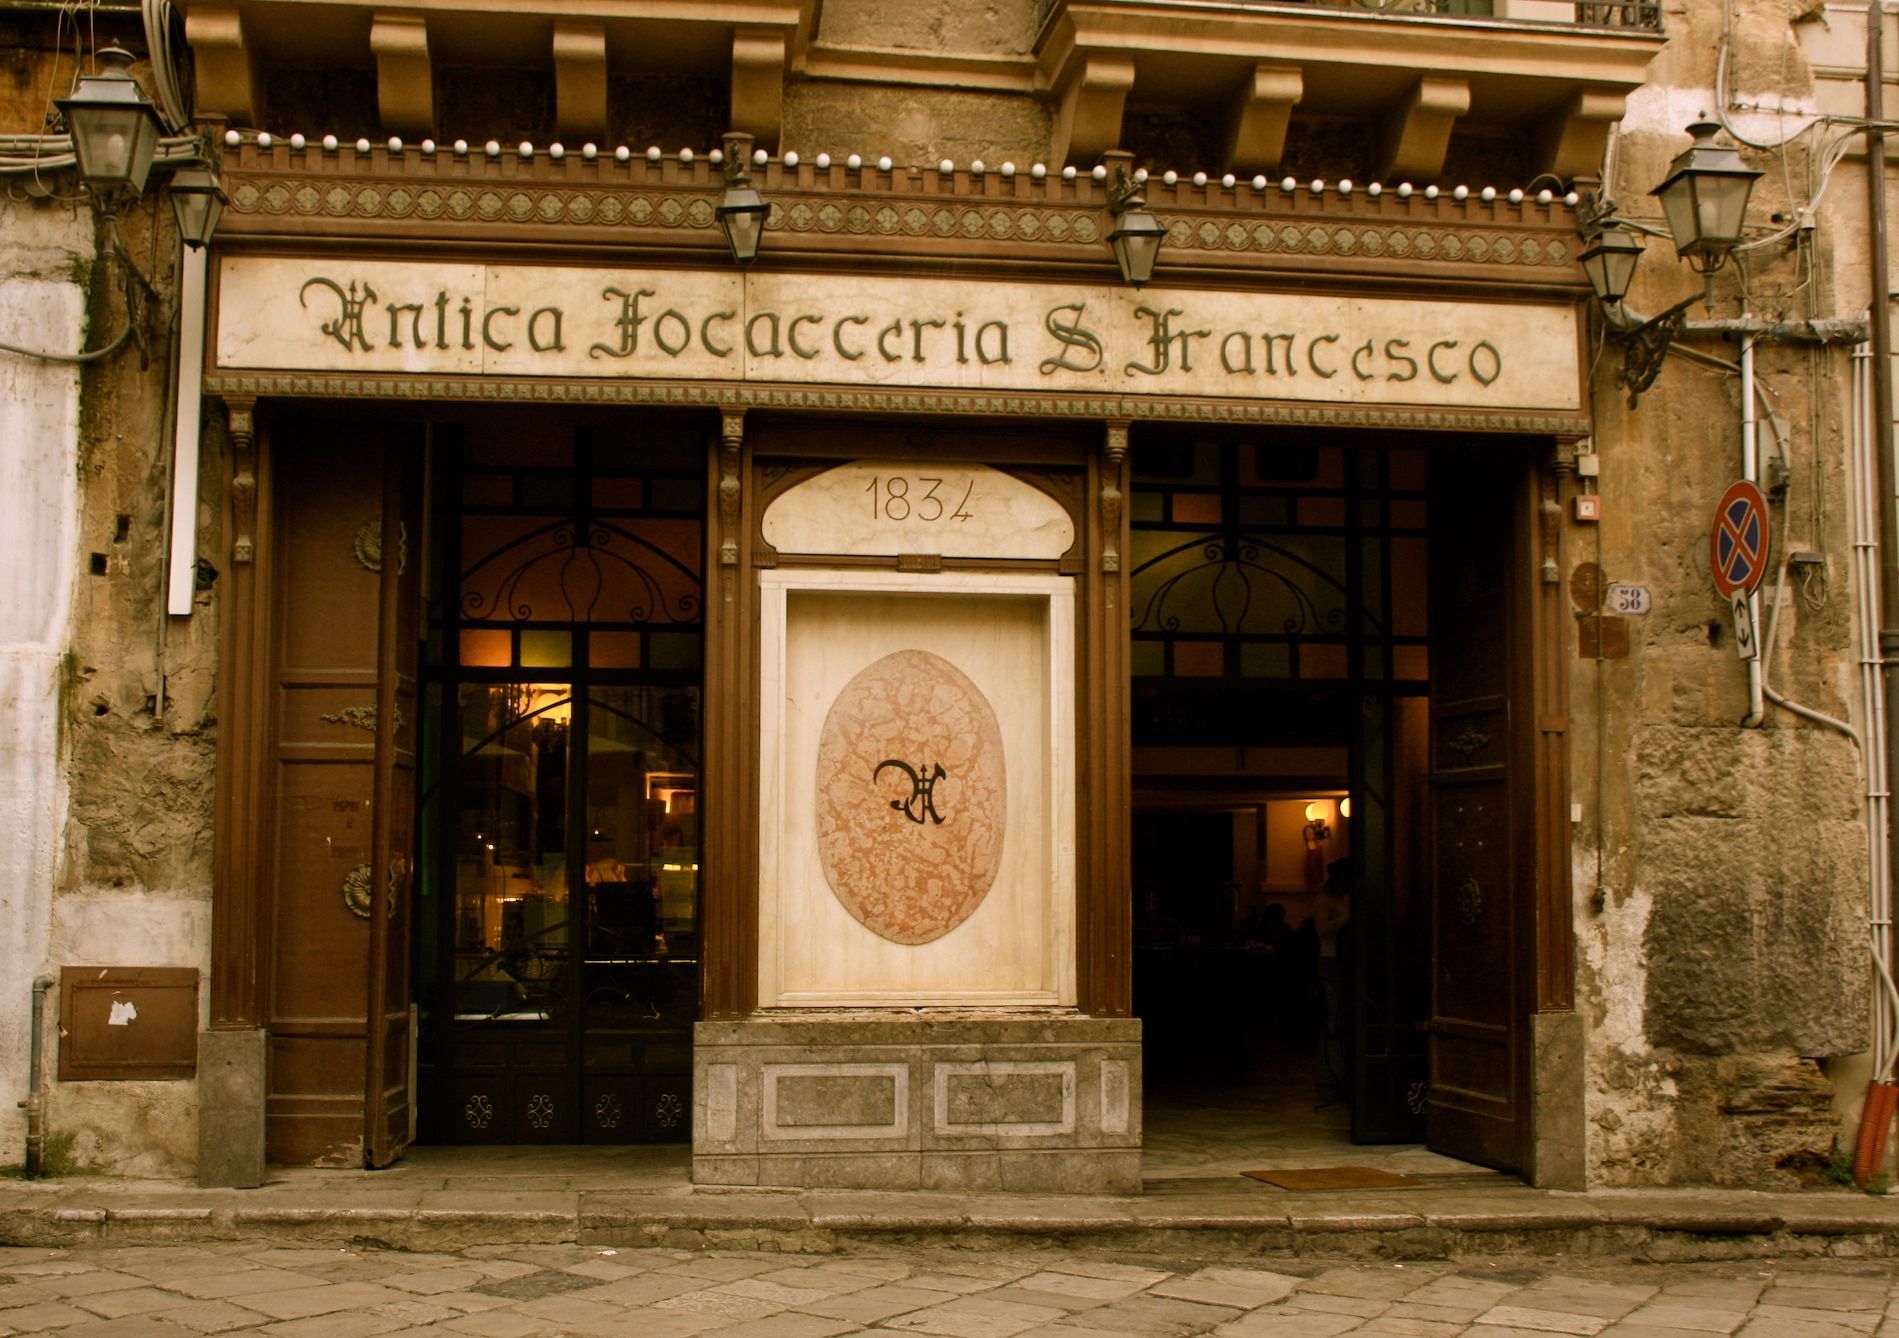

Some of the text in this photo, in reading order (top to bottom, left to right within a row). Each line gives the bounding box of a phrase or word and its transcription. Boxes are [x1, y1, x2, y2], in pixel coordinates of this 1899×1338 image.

[299, 276, 566, 354] Antica
[590, 287, 1012, 366] Focacceria
[1124, 306, 1502, 387] Francesco
[865, 476, 974, 522] 1834
[1619, 589, 1641, 610] 58
